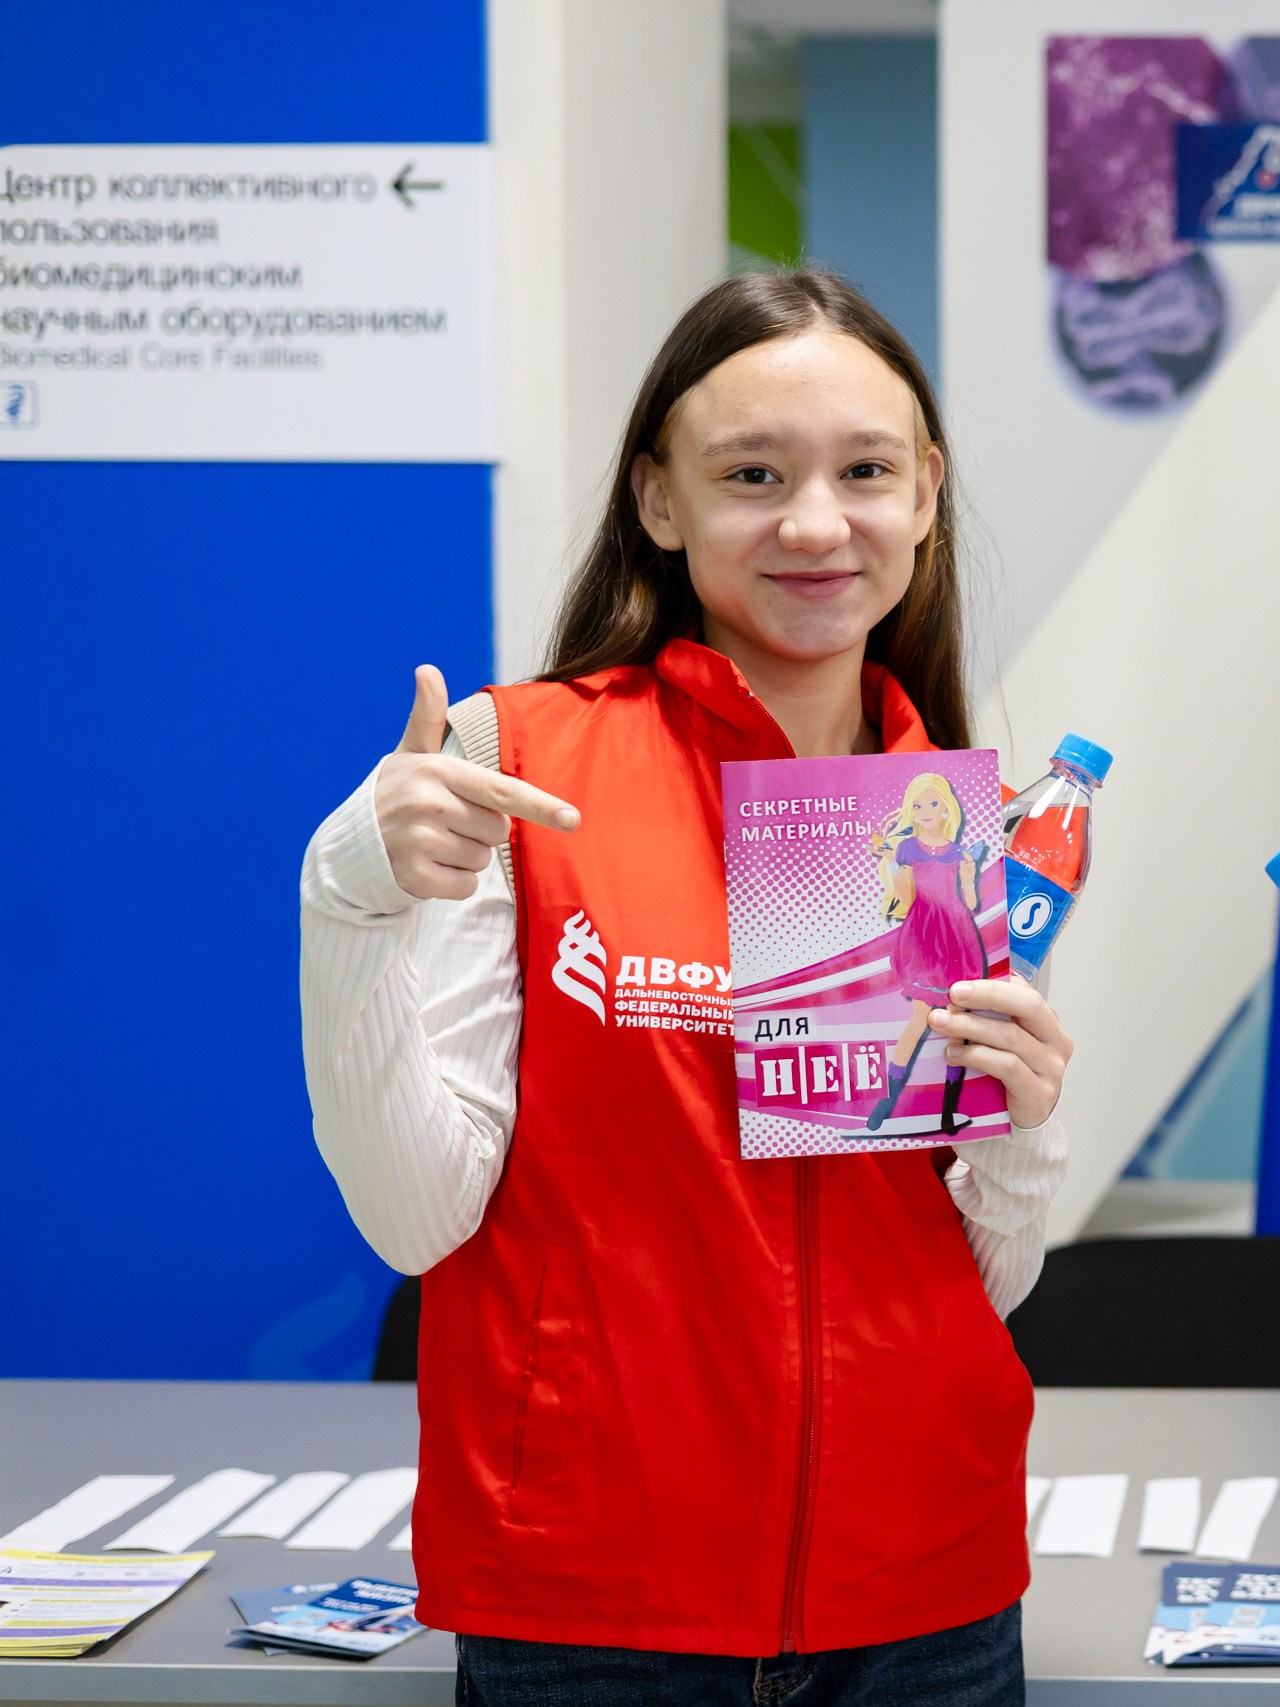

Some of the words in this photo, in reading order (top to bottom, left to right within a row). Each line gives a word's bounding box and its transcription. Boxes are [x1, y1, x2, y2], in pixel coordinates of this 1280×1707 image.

[108, 172, 378, 199] коллективного
[160, 304, 447, 339] оборудованием
[139, 342, 202, 369] Core
[211, 342, 323, 369] Facilities
[739, 795, 858, 818] СЕКРЕТНЫЕ
[741, 820, 873, 842] МАТЕРИАЛЫ
[615, 955, 733, 993] ДВФУ
[615, 988, 734, 1006] ДАЛЬНЕВОСТОЧНЫ
[615, 1014, 736, 1036] УНИВЕРСИТЕТ
[755, 1016, 810, 1042] ДЛЯ
[760, 1045, 883, 1097] НЕЁ
